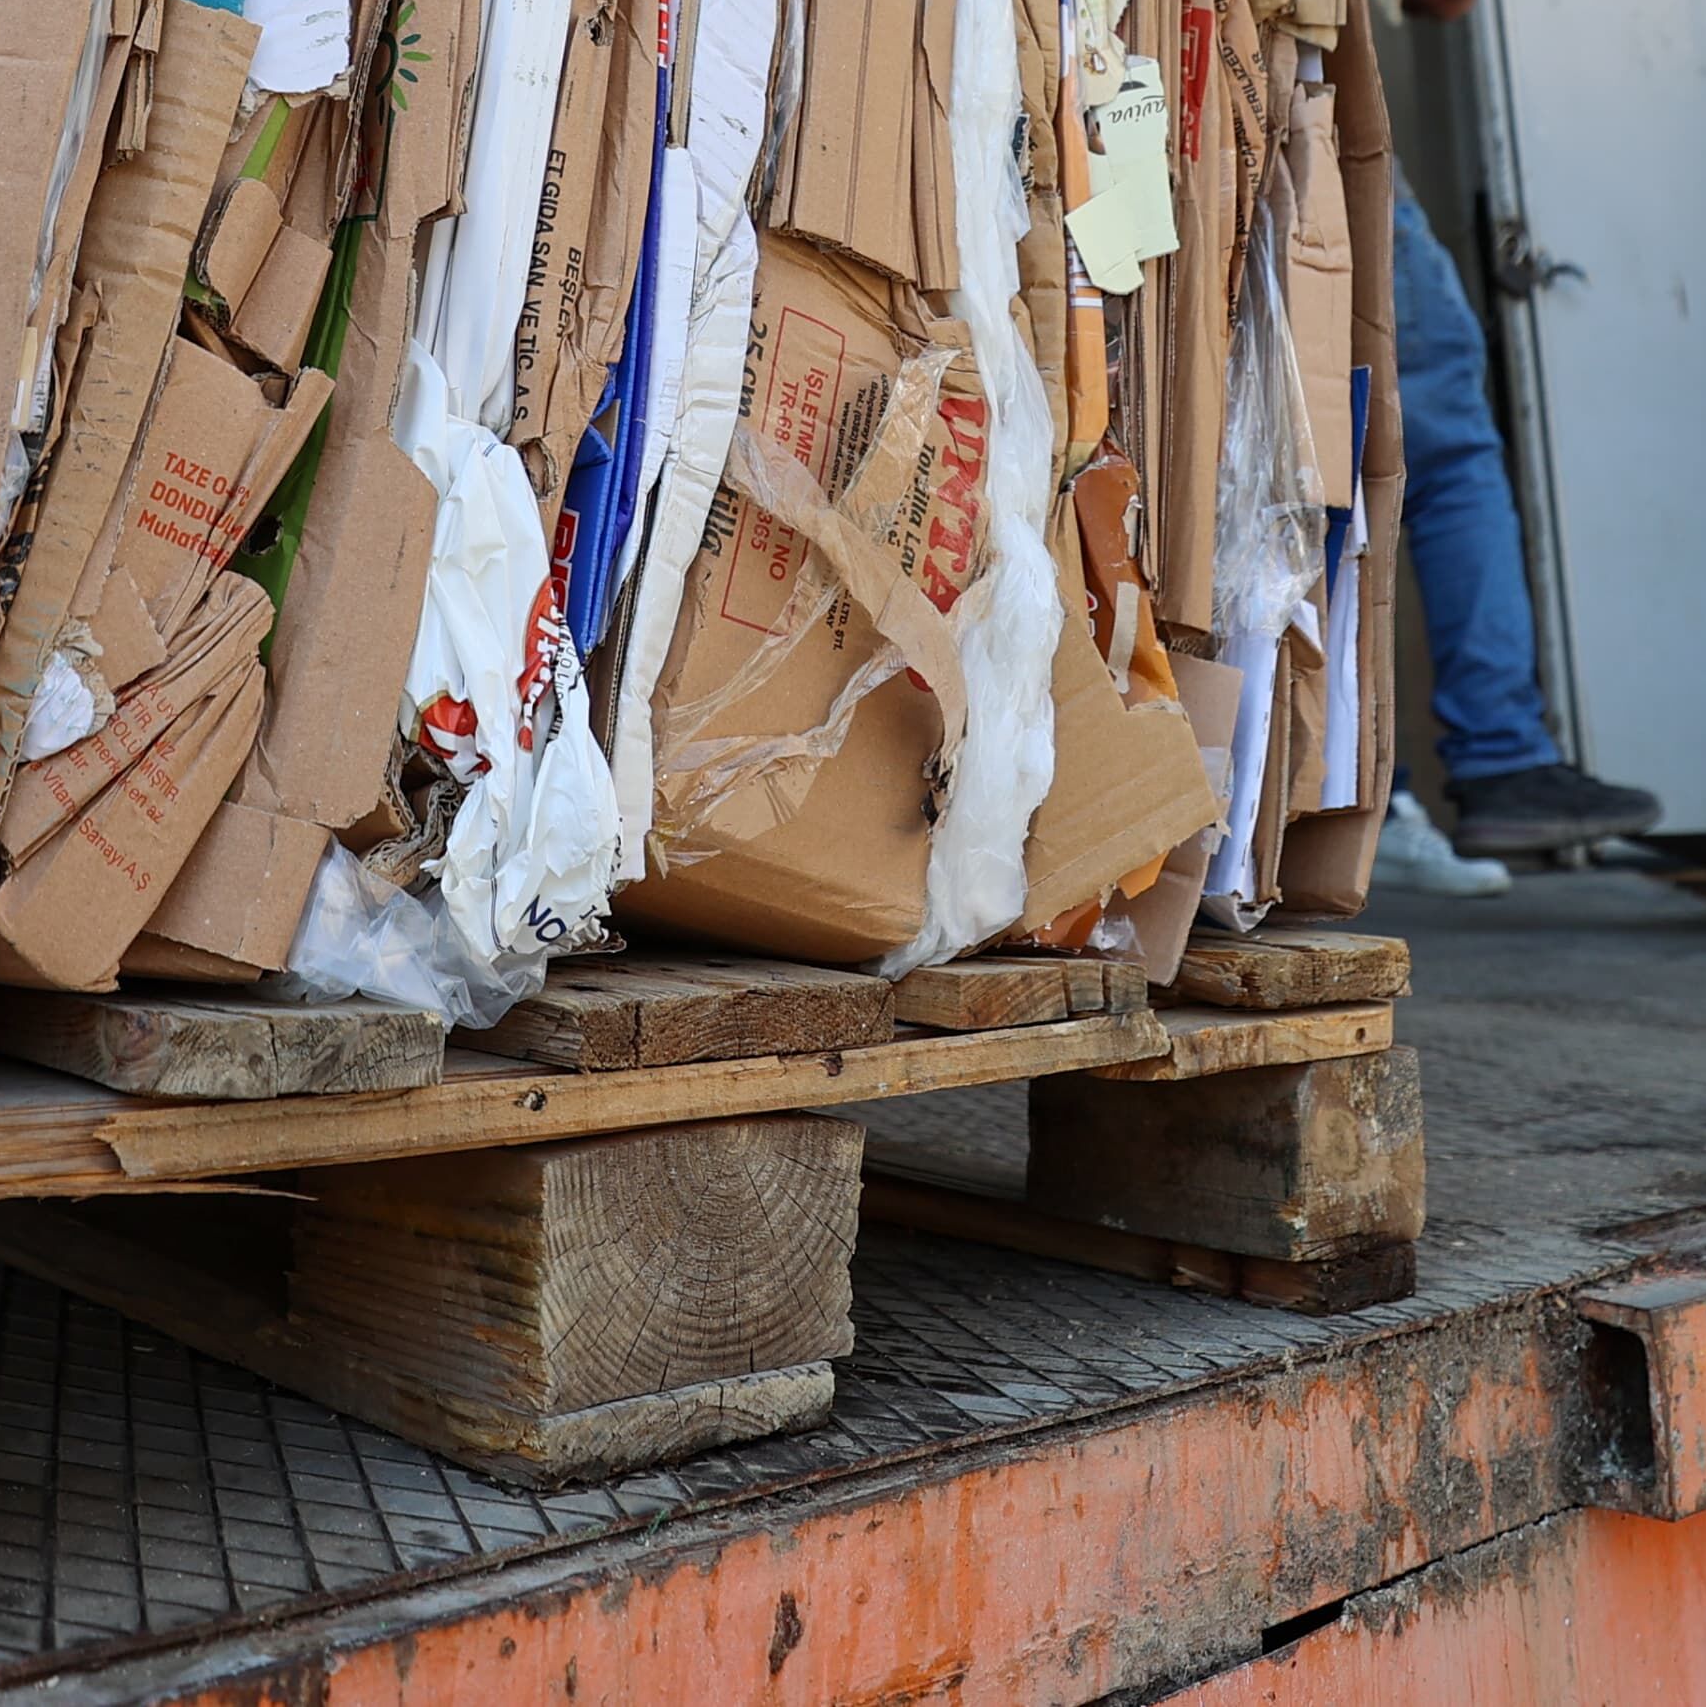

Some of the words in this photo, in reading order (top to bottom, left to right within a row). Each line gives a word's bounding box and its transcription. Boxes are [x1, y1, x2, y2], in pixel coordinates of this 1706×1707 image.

[546, 148, 566, 179] ET
[520, 299, 542, 331] VE
[794, 364, 829, 468] İŞLETME
[164, 451, 212, 490] TAZE
